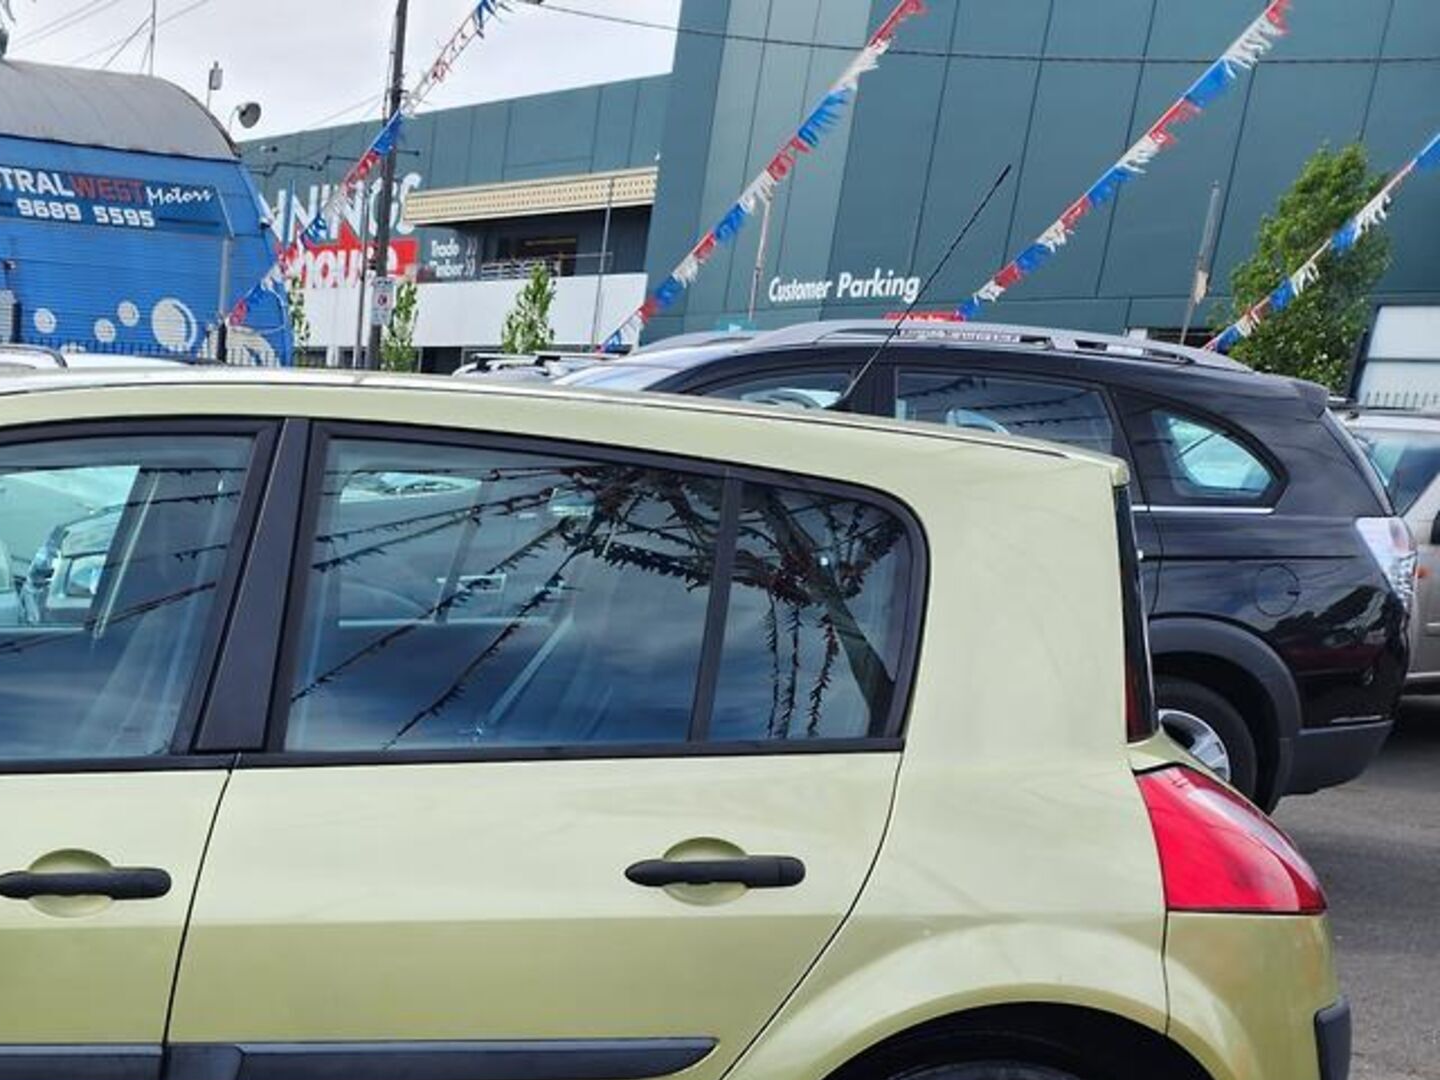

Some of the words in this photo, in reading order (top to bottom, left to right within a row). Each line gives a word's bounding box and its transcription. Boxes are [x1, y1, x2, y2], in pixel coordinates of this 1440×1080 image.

[146, 185, 214, 207] Motors
[16, 198, 83, 222] 9689
[93, 205, 155, 229] 5595
[768, 275, 833, 303] Customer
[836, 267, 920, 304] Parking
